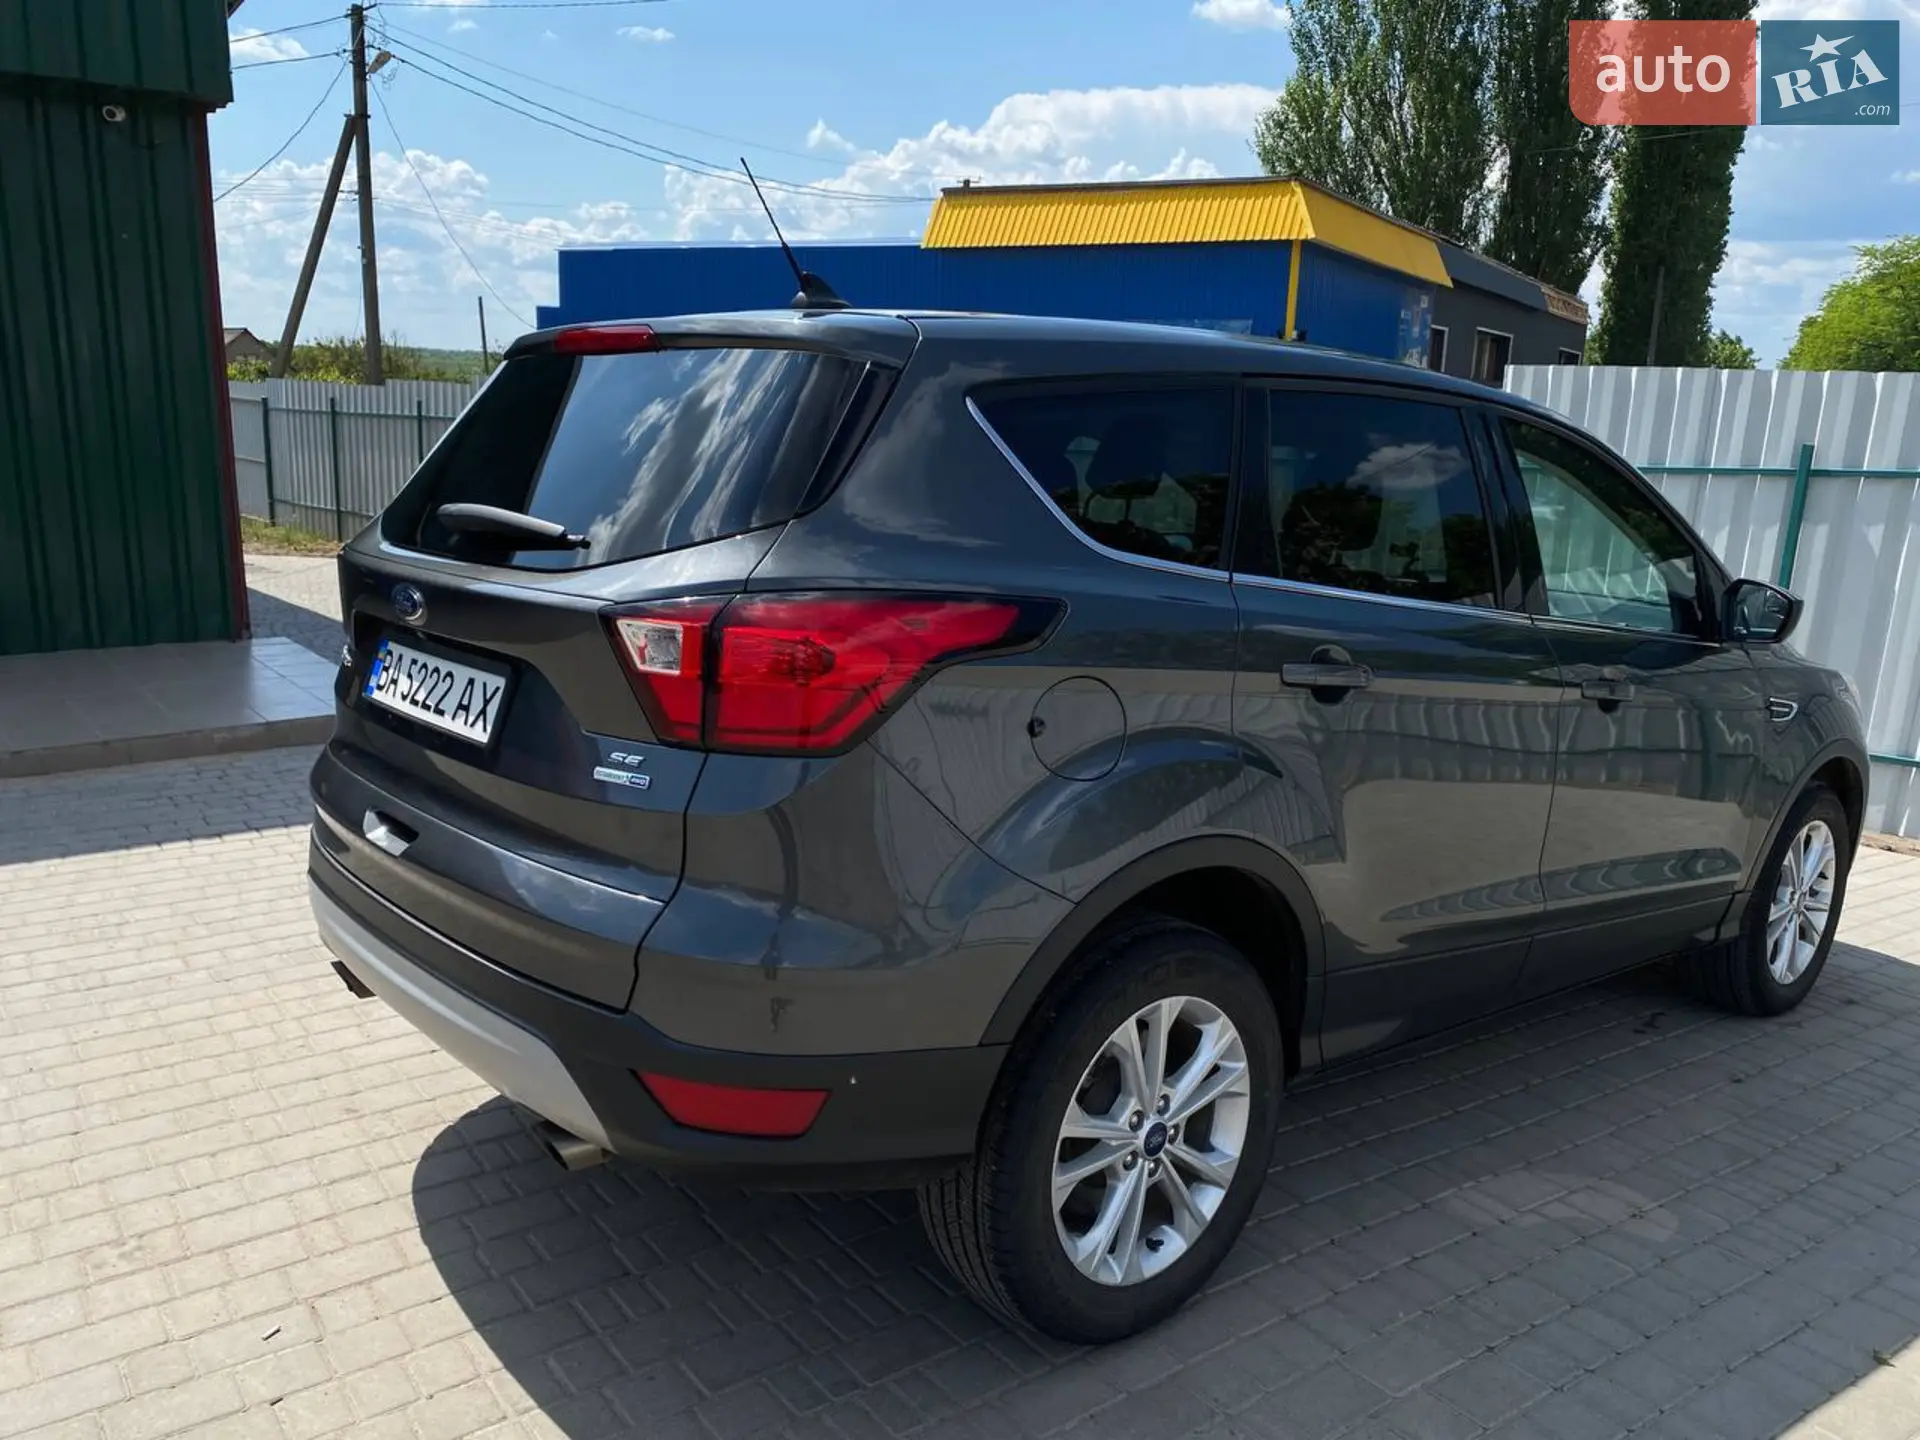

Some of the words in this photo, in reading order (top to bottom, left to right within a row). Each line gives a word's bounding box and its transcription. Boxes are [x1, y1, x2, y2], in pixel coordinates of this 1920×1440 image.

[376, 649, 403, 698] BA
[400, 658, 455, 717] 5222
[451, 677, 501, 733] AX
[607, 751, 645, 767] SE
